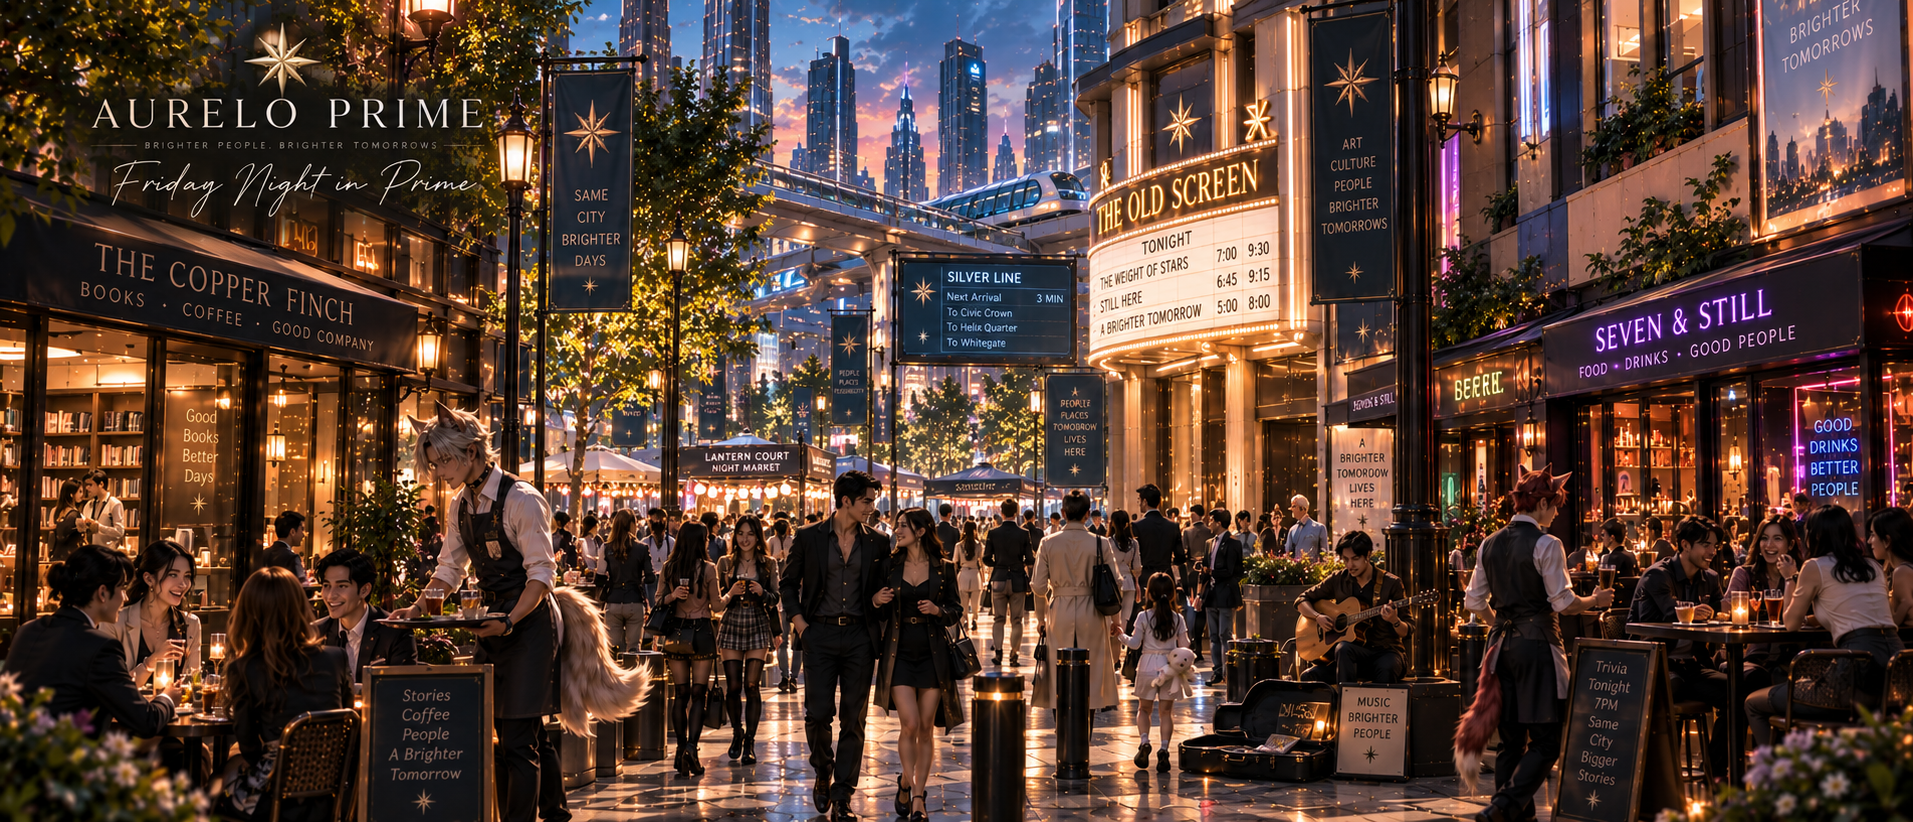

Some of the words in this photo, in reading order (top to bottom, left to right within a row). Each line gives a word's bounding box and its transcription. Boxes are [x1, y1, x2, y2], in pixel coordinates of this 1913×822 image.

[1790, 0, 1861, 44] BRIGHTER
[1782, 18, 1874, 73] TOMORROWS
[1342, 137, 1363, 150] ART
[1330, 155, 1377, 172] CULTURE
[1334, 177, 1372, 192] PEOPLE
[574, 188, 609, 202] SAME
[1097, 196, 1123, 235] THE
[1128, 184, 1164, 222] OLD
[1172, 159, 1259, 209] SCREEN
[1329, 197, 1379, 214] BRIGHTER
[577, 210, 606, 224] CITY
[1321, 217, 1388, 235] TOMORROWS
[562, 232, 621, 246] BRIGHTER
[1142, 230, 1192, 255] TONIGHT
[575, 254, 607, 267] DAYS
[1100, 276, 1113, 290] THE
[1115, 266, 1144, 284] WEIGHT
[1146, 263, 1158, 277] OF
[1160, 256, 1189, 274] STARS
[1216, 246, 1237, 262] 7:00
[1248, 241, 1270, 257] 9:30
[94, 242, 156, 282] THE
[169, 261, 271, 307] COPPER
[287, 287, 354, 326] FINCH
[948, 271, 990, 283] SILVER
[994, 272, 1022, 284] LINE
[946, 292, 968, 301] Next
[971, 292, 1002, 302] Arrival
[1036, 294, 1042, 303] 3
[1046, 294, 1064, 303] MIN
[1100, 295, 1119, 313] STILL
[1121, 290, 1143, 307] HERE
[1216, 272, 1238, 288] 6:45
[1248, 267, 1270, 283] 9:15
[80, 281, 145, 308] BOOKS
[183, 302, 243, 327] COFFEE
[272, 321, 311, 340] GOOD
[316, 330, 374, 352] COMPANY
[947, 307, 958, 317] To
[960, 307, 982, 317] Civic
[984, 308, 1013, 318] Crown
[1100, 324, 1105, 337] A
[1107, 315, 1145, 334] BRIGHTER
[1147, 303, 1202, 325] TOMORROW
[1217, 298, 1238, 314] 5:00
[1248, 294, 1271, 309] 8:00
[1595, 313, 1662, 352] SEVEN
[1672, 308, 1688, 335] &
[1699, 289, 1772, 330] STILL
[947, 321, 958, 332] To
[984, 323, 1018, 333] Quarter
[947, 337, 958, 347] To
[960, 338, 1006, 349] Whitegate
[1579, 362, 1608, 379] FOOD
[1625, 350, 1669, 370] DRINKS
[1690, 338, 1731, 358] GOOD
[1738, 324, 1796, 349] PEOPLE
[186, 408, 217, 424] Good
[1814, 417, 1853, 434] GOOD
[183, 428, 219, 444] Books
[1064, 435, 1087, 444] LIVES
[1359, 438, 1366, 448] A
[1064, 447, 1086, 456] HERE
[1810, 438, 1858, 454] DRINKS
[182, 448, 219, 464] Better
[705, 452, 751, 462] LANTERN
[755, 451, 790, 461] COURT
[1340, 453, 1385, 463] BRIGHTER
[712, 463, 740, 472] NIGHT
[742, 463, 780, 472] MARKET
[1810, 460, 1859, 476] BETTER
[184, 468, 214, 487] Days
[1349, 483, 1375, 493] LIVES
[1811, 481, 1859, 497] PEOPLE
[1350, 498, 1374, 508] HERE
[1596, 660, 1628, 675] Trivia
[1588, 677, 1630, 695] Tonight
[402, 688, 451, 702] Stories
[1357, 697, 1391, 708] MUSIC
[1594, 697, 1619, 711] 7PM
[402, 707, 450, 724] Coffee
[1348, 712, 1398, 724] BRIGHTER
[1588, 715, 1619, 730] Same
[402, 727, 450, 744] People
[1353, 728, 1391, 739] PEOPLE
[1589, 733, 1614, 751] City
[388, 748, 399, 761] A
[404, 747, 463, 764] Brighter
[1581, 750, 1618, 768] Bigger
[390, 768, 462, 781] Tomorrow
[1577, 768, 1616, 786] Stories
